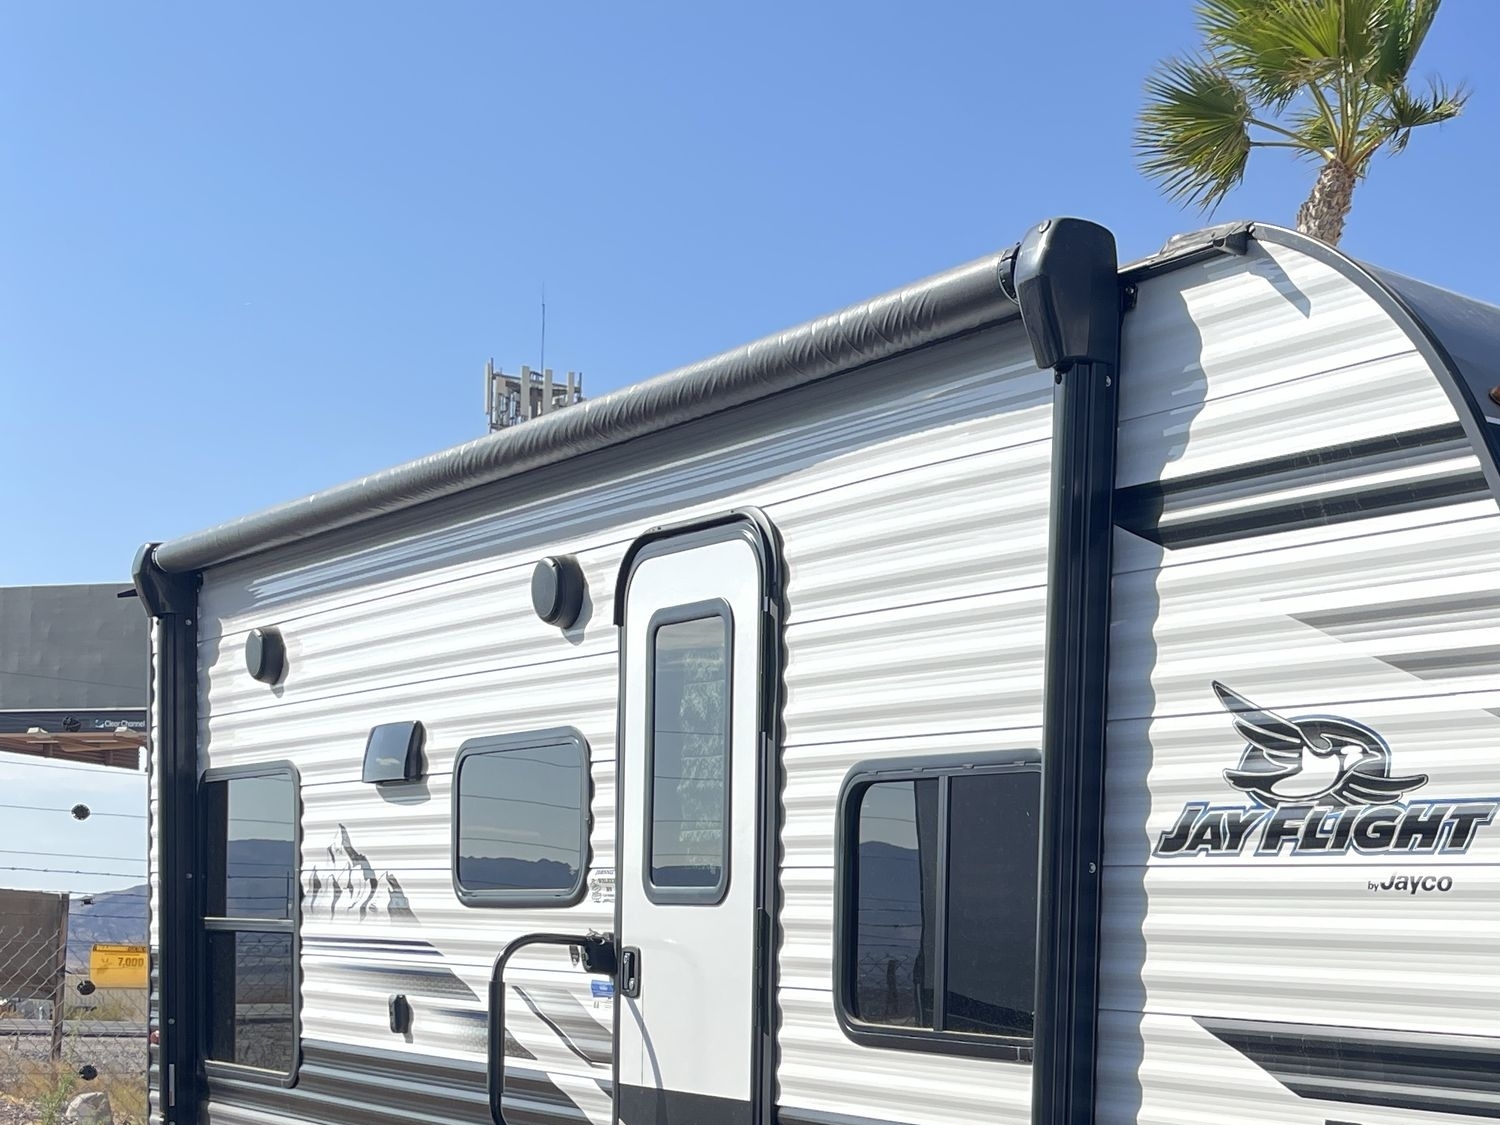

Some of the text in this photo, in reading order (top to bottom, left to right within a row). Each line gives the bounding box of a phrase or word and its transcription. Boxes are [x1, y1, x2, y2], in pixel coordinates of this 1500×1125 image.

[1152, 800, 1273, 857] JAY
[1367, 871, 1454, 895] by Jayco
